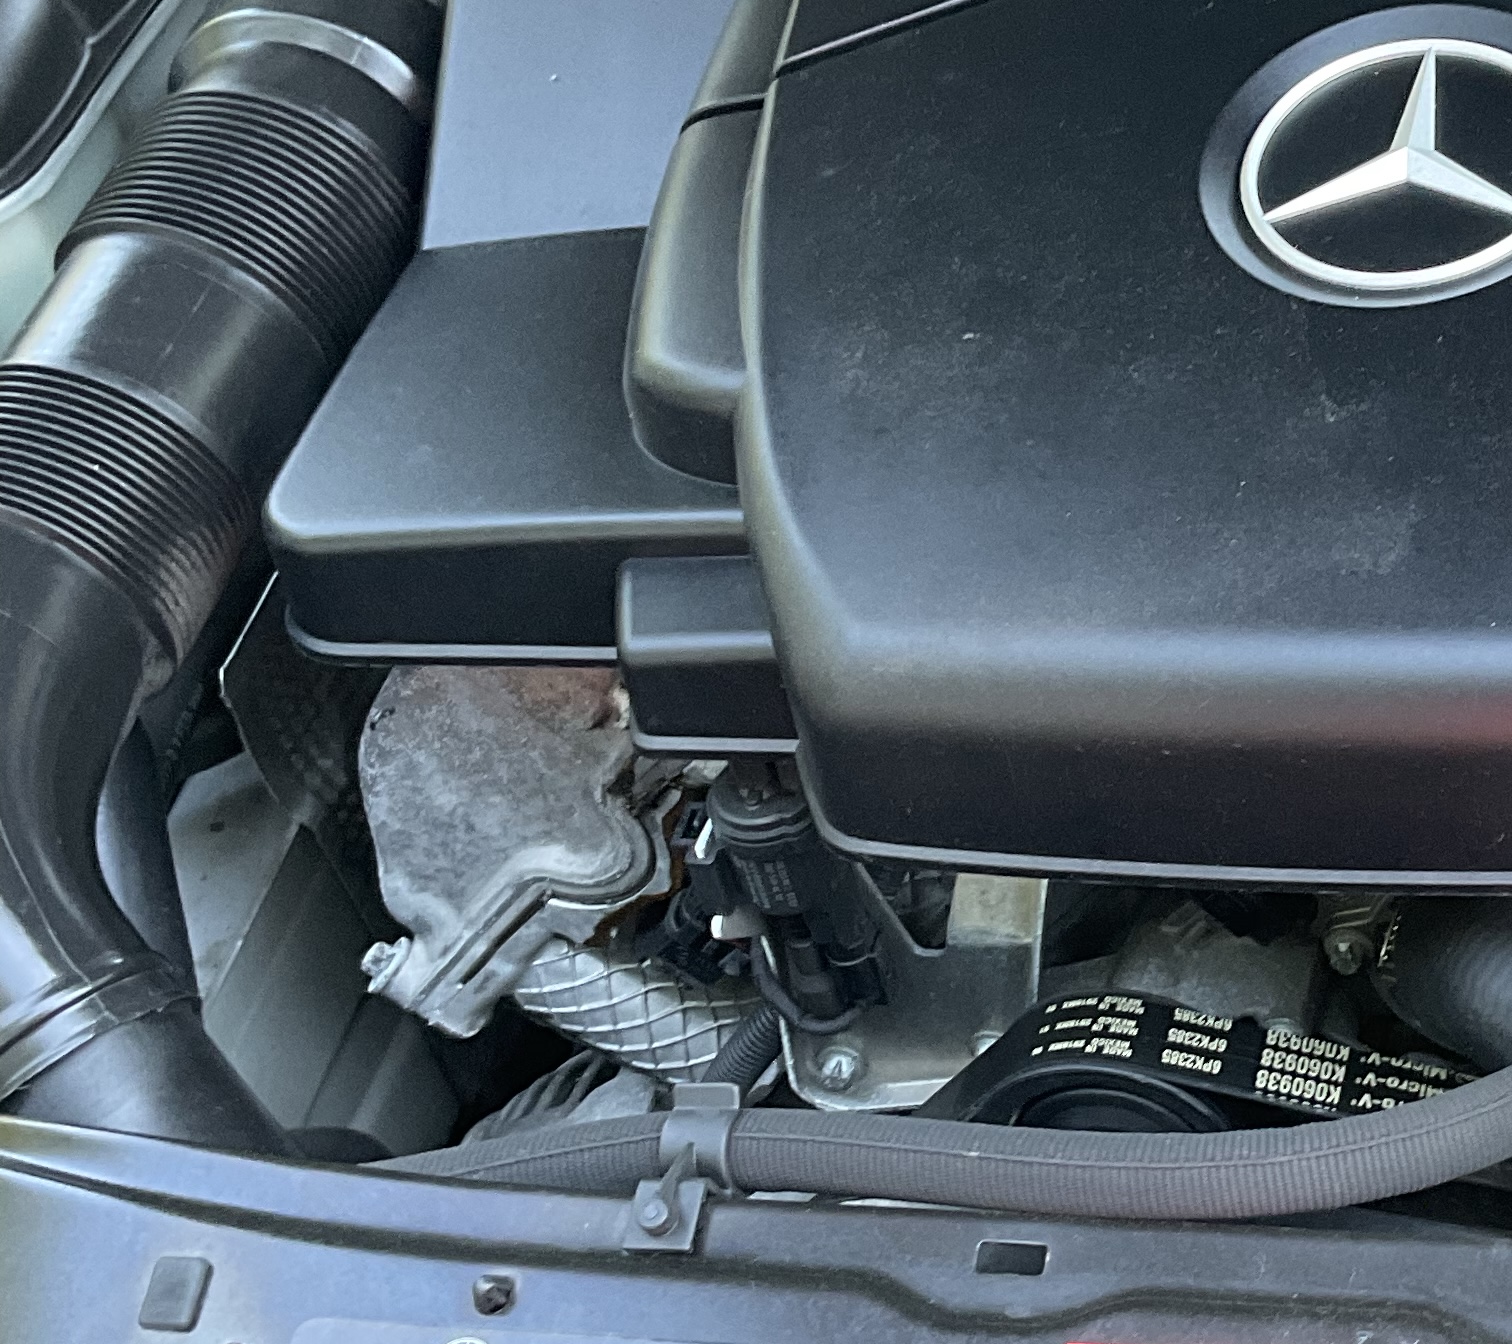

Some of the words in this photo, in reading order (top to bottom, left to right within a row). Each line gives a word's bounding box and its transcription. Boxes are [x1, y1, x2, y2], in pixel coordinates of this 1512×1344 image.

[1166, 1027, 1228, 1053] 6PK2385
[1161, 1048, 1222, 1075] 6PK2385
[1259, 1048, 1347, 1084] K060938
[1254, 1069, 1342, 1105] K060938
